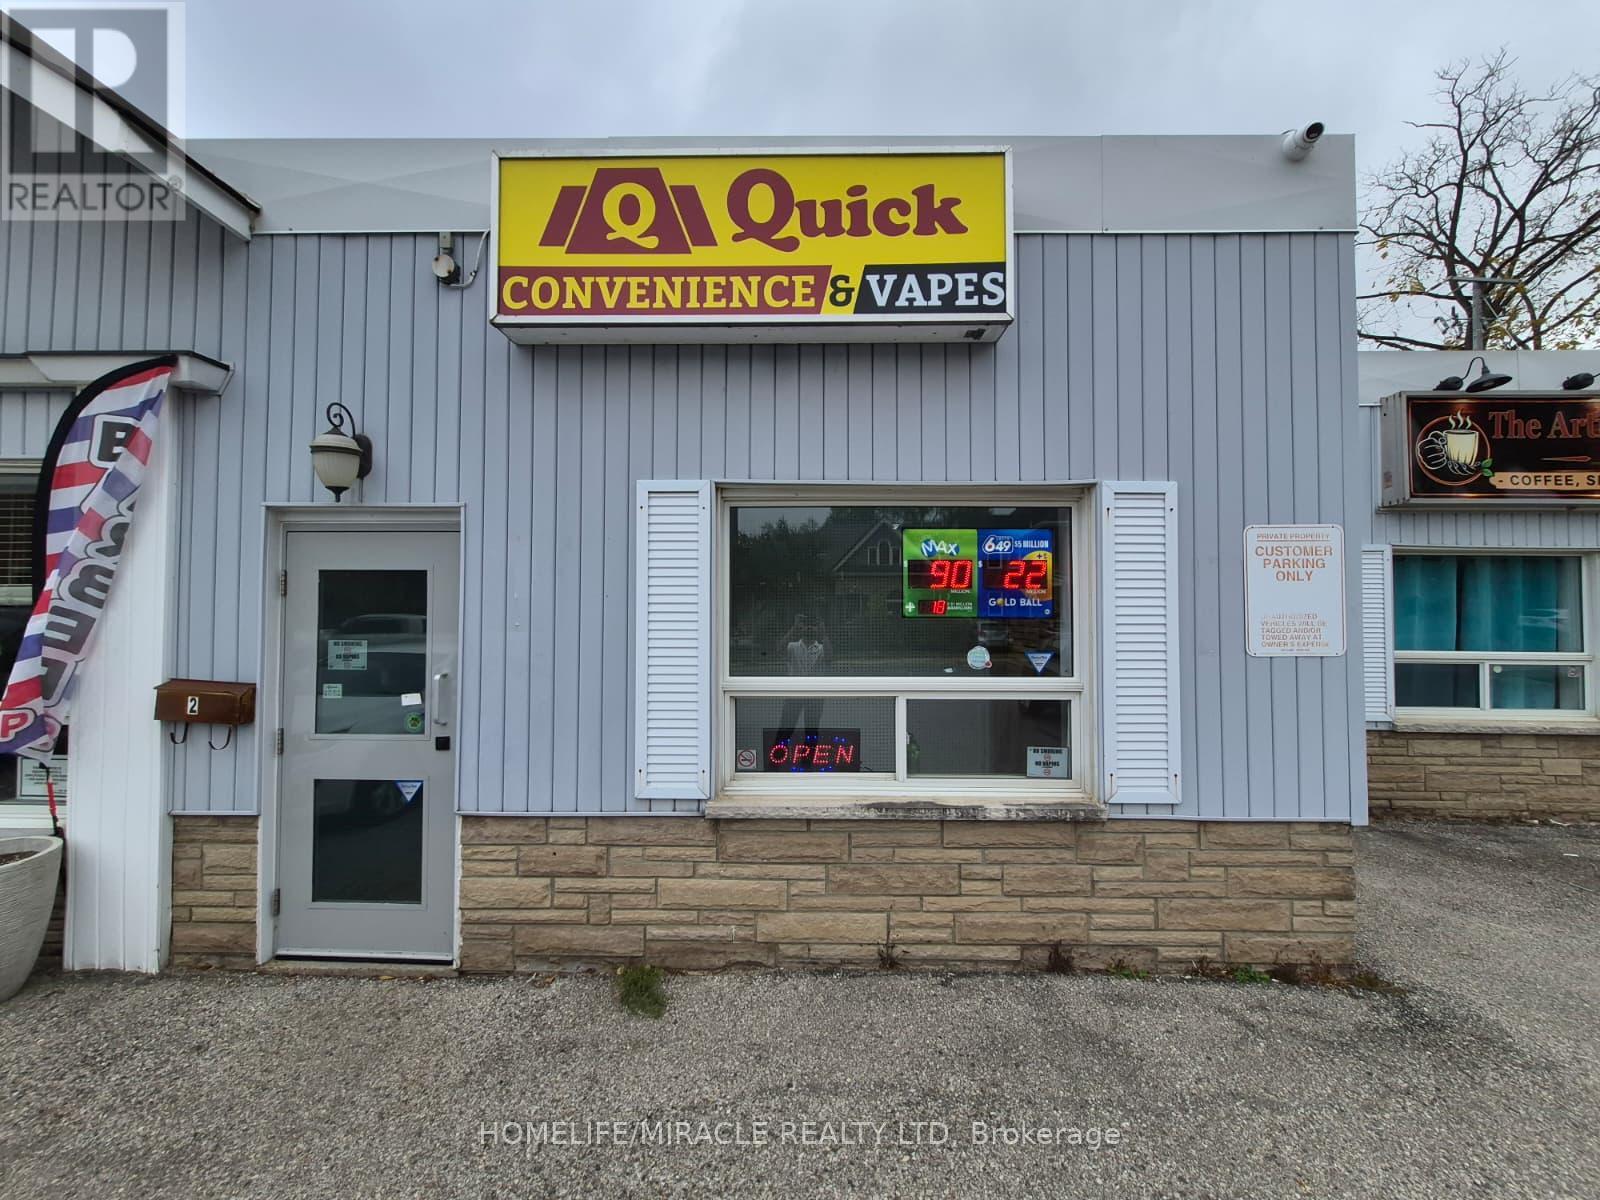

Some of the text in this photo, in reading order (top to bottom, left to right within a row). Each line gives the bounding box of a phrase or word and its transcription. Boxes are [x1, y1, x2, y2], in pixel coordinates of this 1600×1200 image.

[602, 182, 659, 249] Q
[726, 168, 969, 253] Quick
[502, 275, 815, 310] CONVENIENCE
[829, 274, 855, 307] &
[865, 271, 1006, 307] VAPES
[1488, 409, 1542, 439] The
[1510, 475, 1580, 488] COFFEE,
[1023, 540, 1049, 548] MILLION
[1255, 545, 1333, 557] CUSTOMER
[930, 560, 973, 589] 90
[1003, 560, 1048, 589] 22
[1263, 558, 1326, 569] PARKING
[1276, 571, 1313, 582] ONLY
[1020, 598, 1043, 607] BALL
[189, 697, 198, 714] 2
[769, 744, 854, 764] OPEN
